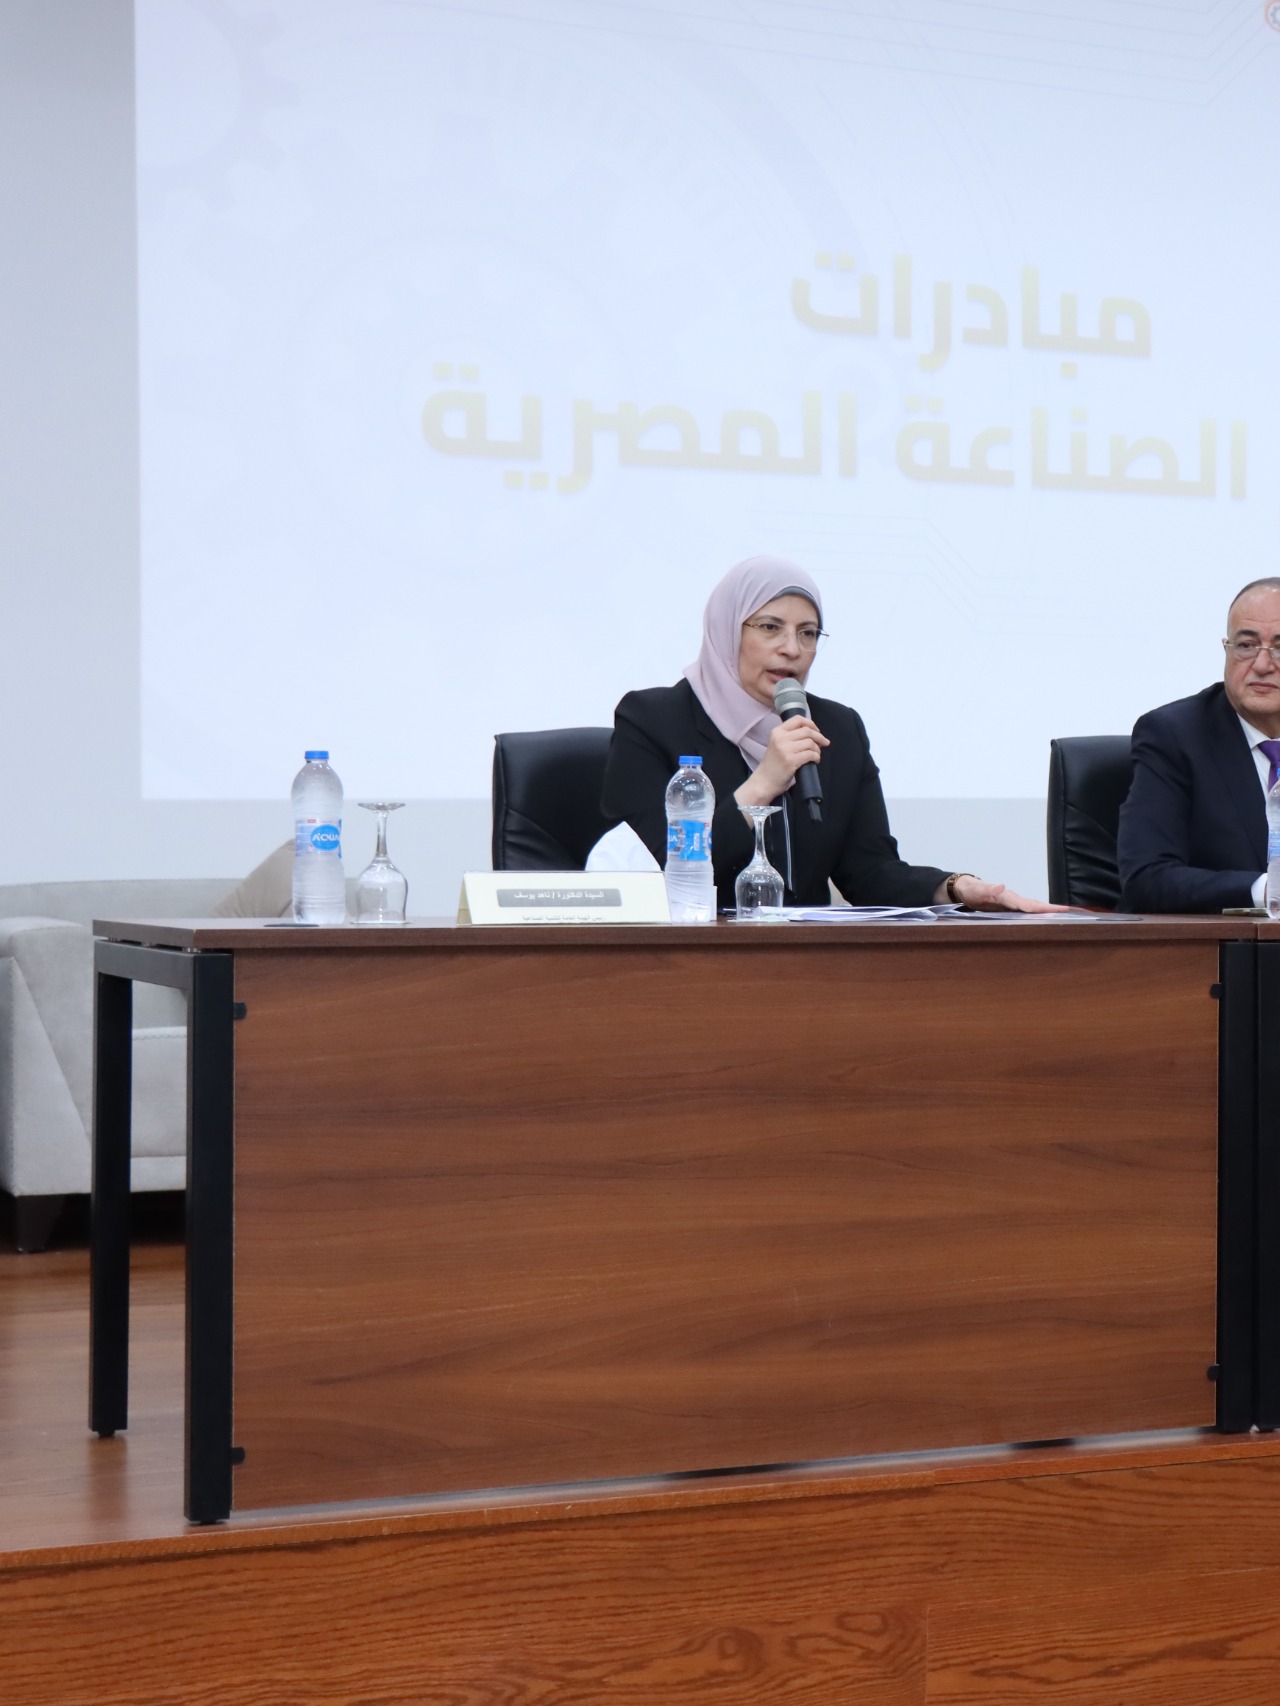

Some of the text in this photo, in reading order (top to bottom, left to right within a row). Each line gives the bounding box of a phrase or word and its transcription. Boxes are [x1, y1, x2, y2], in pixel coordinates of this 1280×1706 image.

[791, 251, 1152, 379] مبادرات
[420, 361, 857, 495] المصرية
[894, 395, 1248, 500] الصناعة
